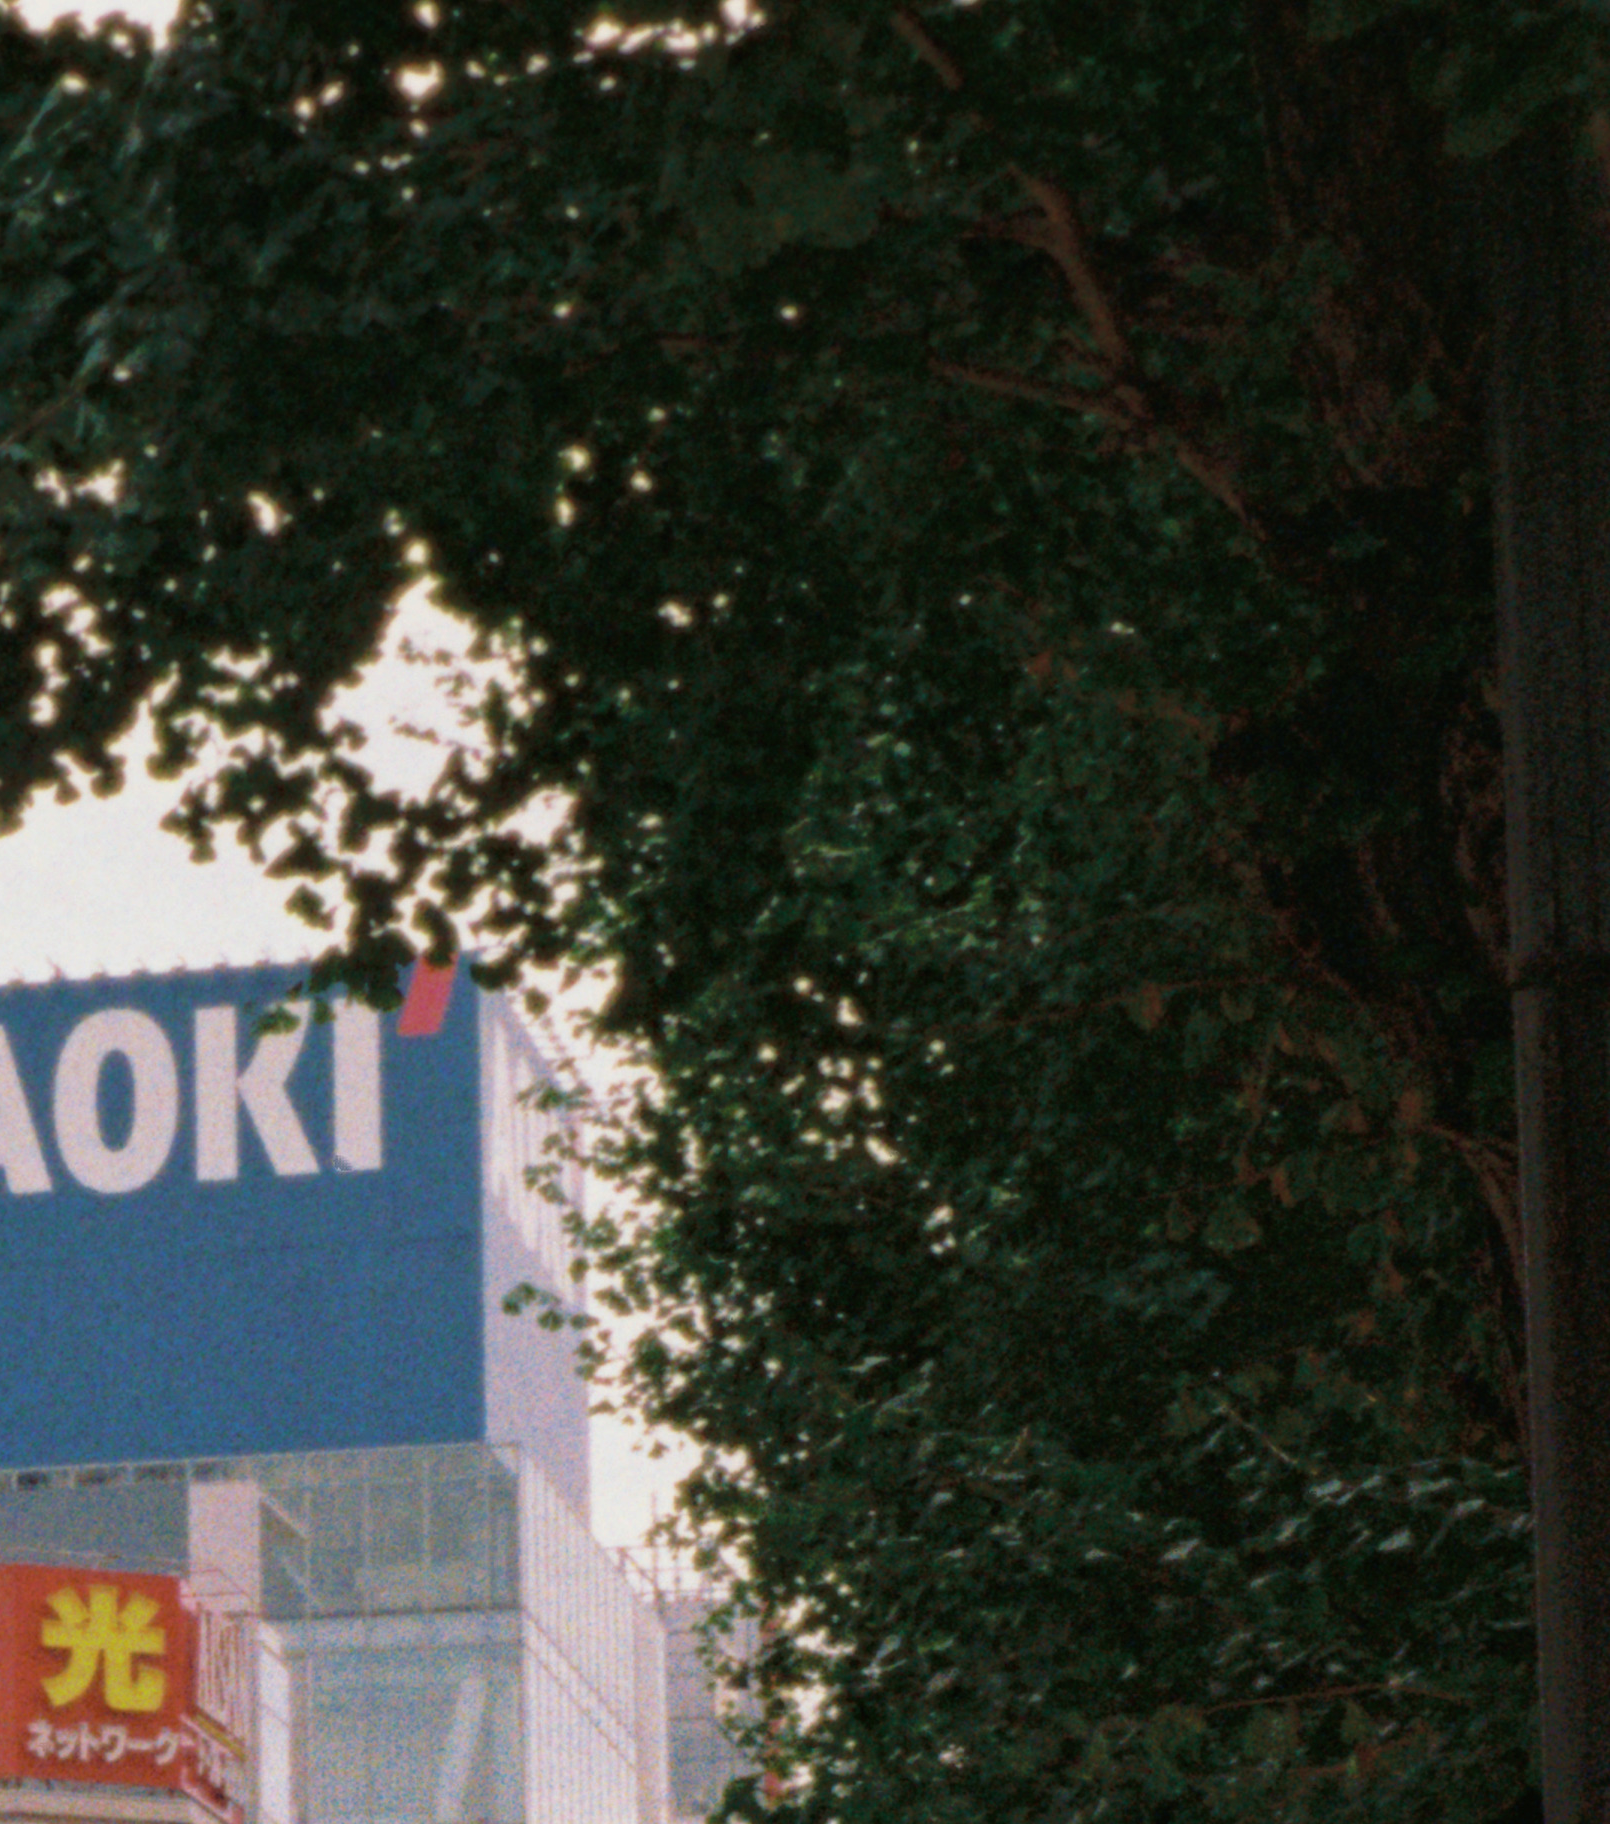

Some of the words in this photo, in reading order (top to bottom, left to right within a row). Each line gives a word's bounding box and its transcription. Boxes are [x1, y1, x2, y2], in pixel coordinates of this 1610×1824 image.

[40, 1584, 167, 1713] 光
[28, 1721, 179, 1767] ネットワーク
